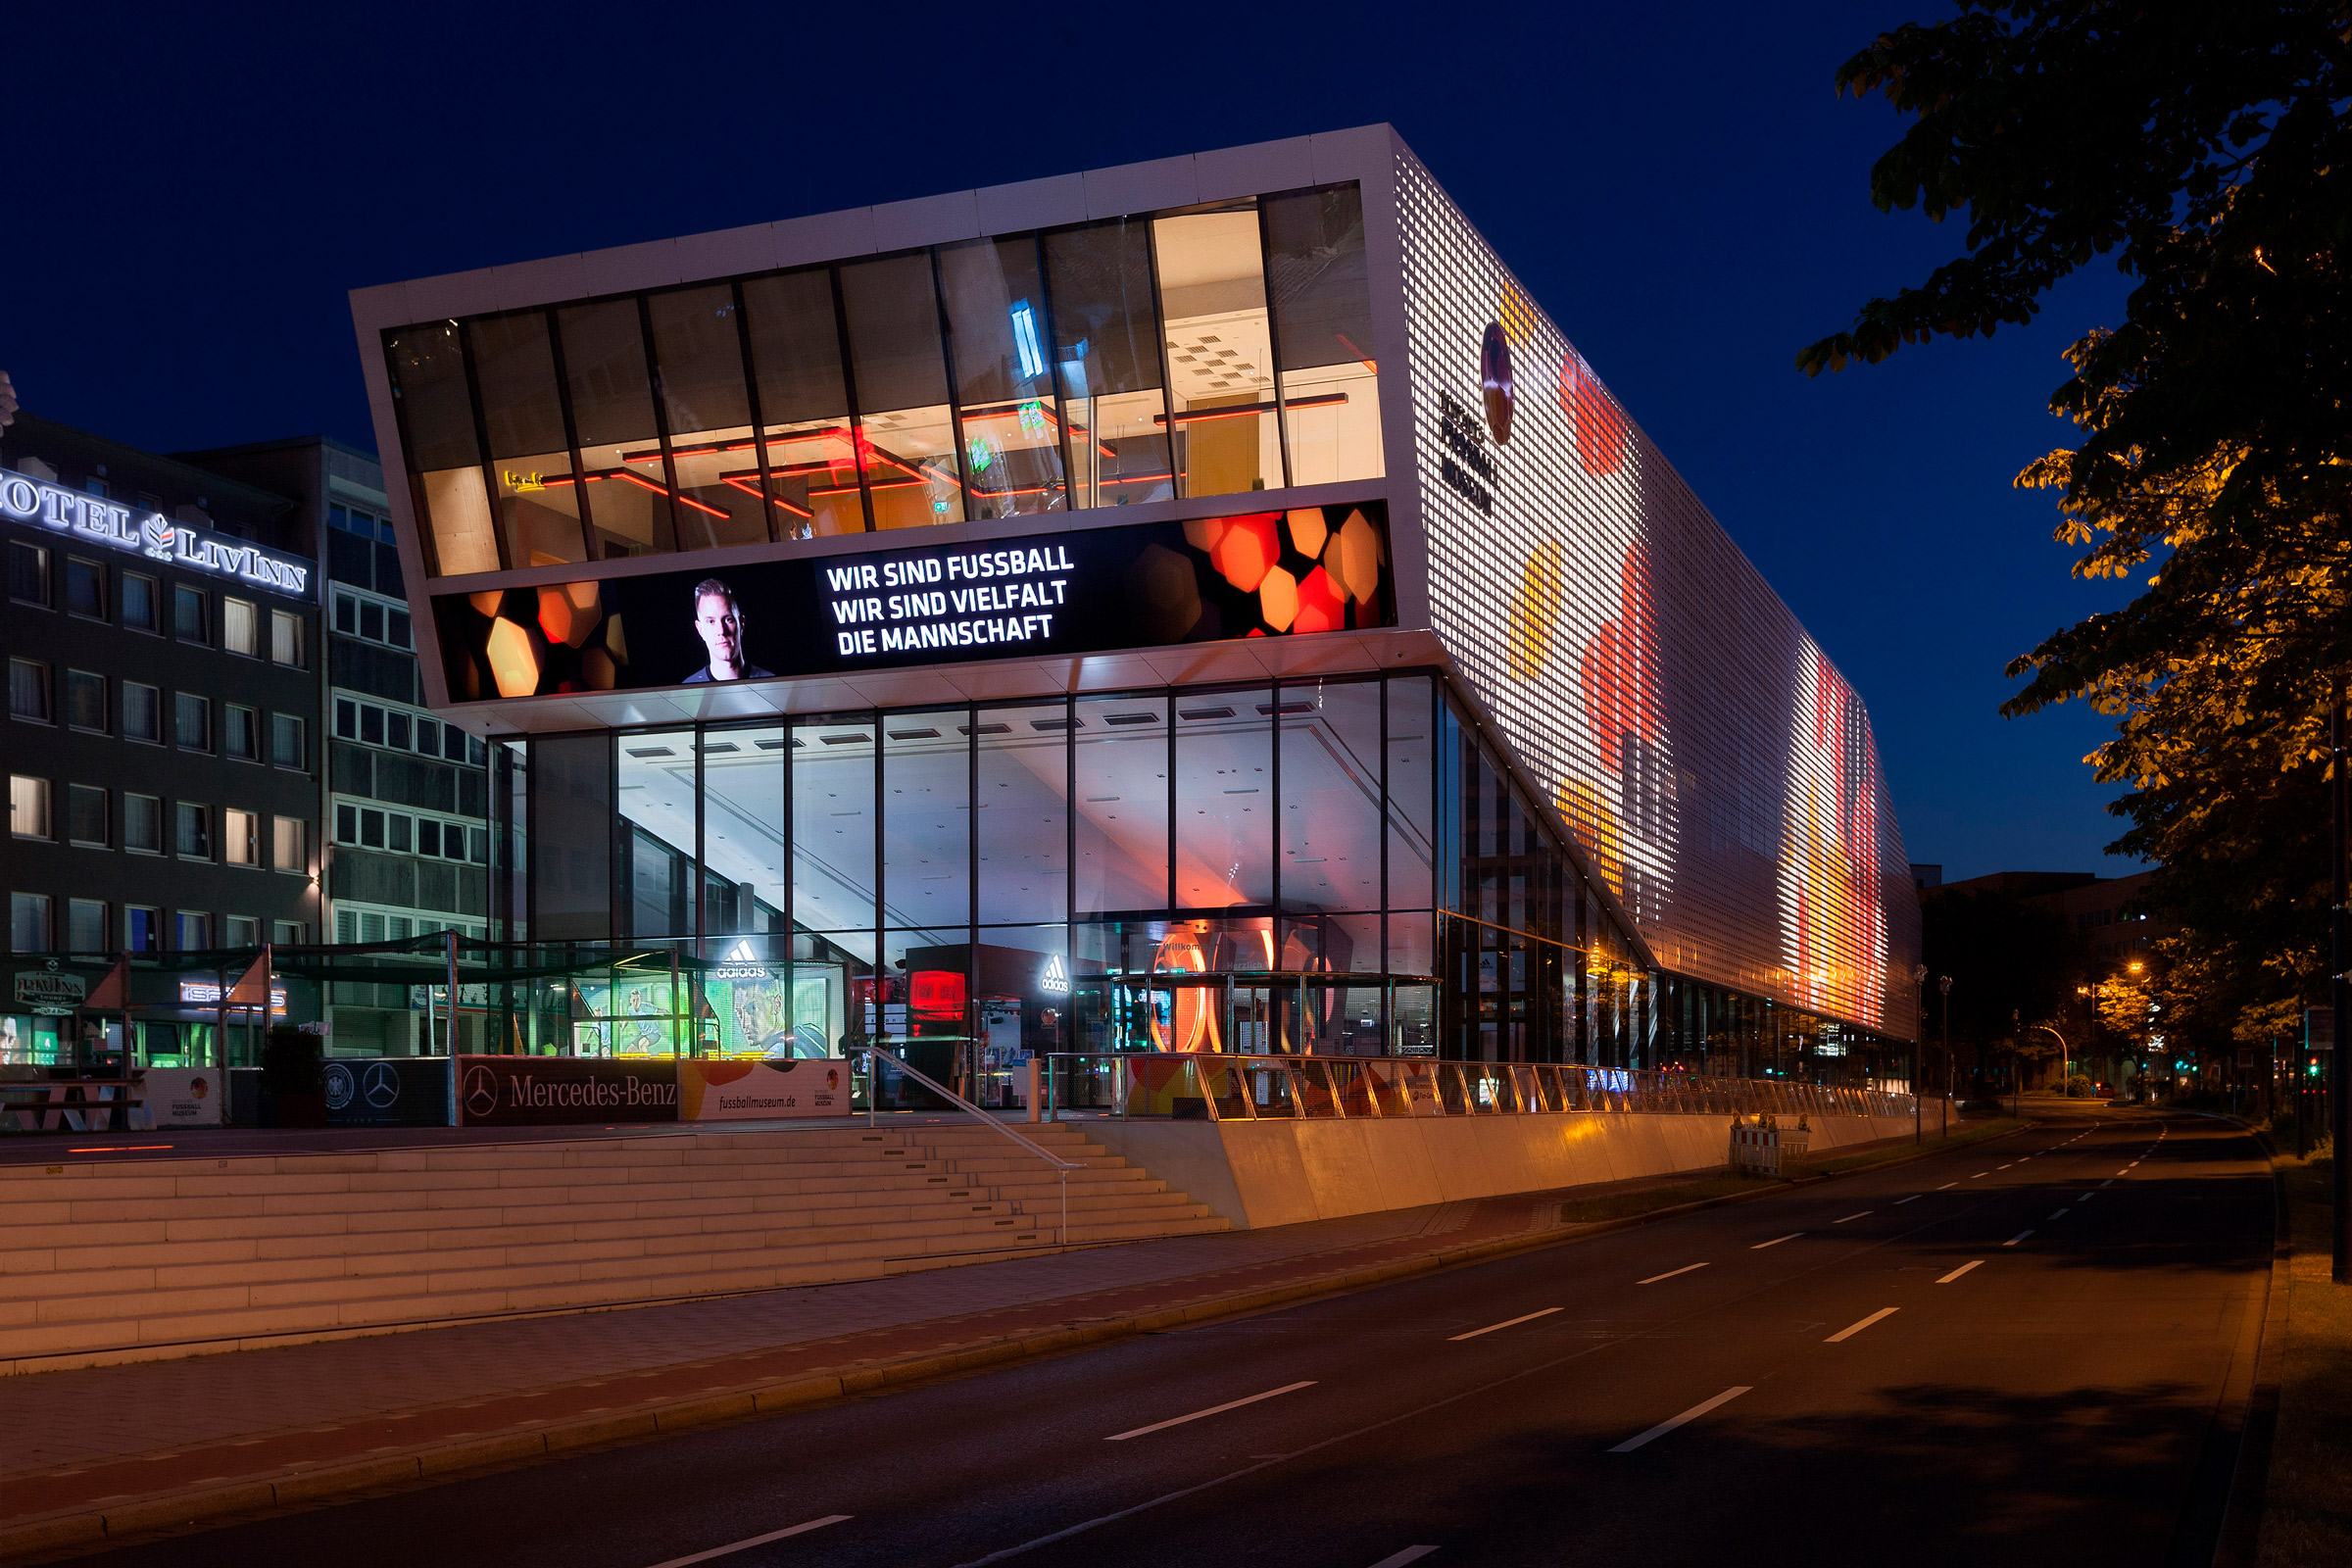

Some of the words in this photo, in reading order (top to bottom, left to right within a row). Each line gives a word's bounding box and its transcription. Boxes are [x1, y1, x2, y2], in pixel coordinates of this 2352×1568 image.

[1441, 453, 1493, 517] MUSEUM
[0, 472, 140, 547] OTEL
[826, 565, 880, 592] WIR
[883, 558, 942, 587] SIND
[947, 546, 1075, 580] FUSSBALL
[832, 598, 885, 624] WIR
[888, 591, 947, 619] SIND
[951, 580, 1067, 613] VIELFALT
[838, 629, 877, 656] DIE
[881, 613, 1054, 652] MANNSCHAFT
[716, 966, 767, 979] adidas
[1042, 978, 1069, 993] adidas
[510, 1074, 677, 1107] Mercedes-Benz
[718, 1095, 796, 1112] fussballmuseum.de
